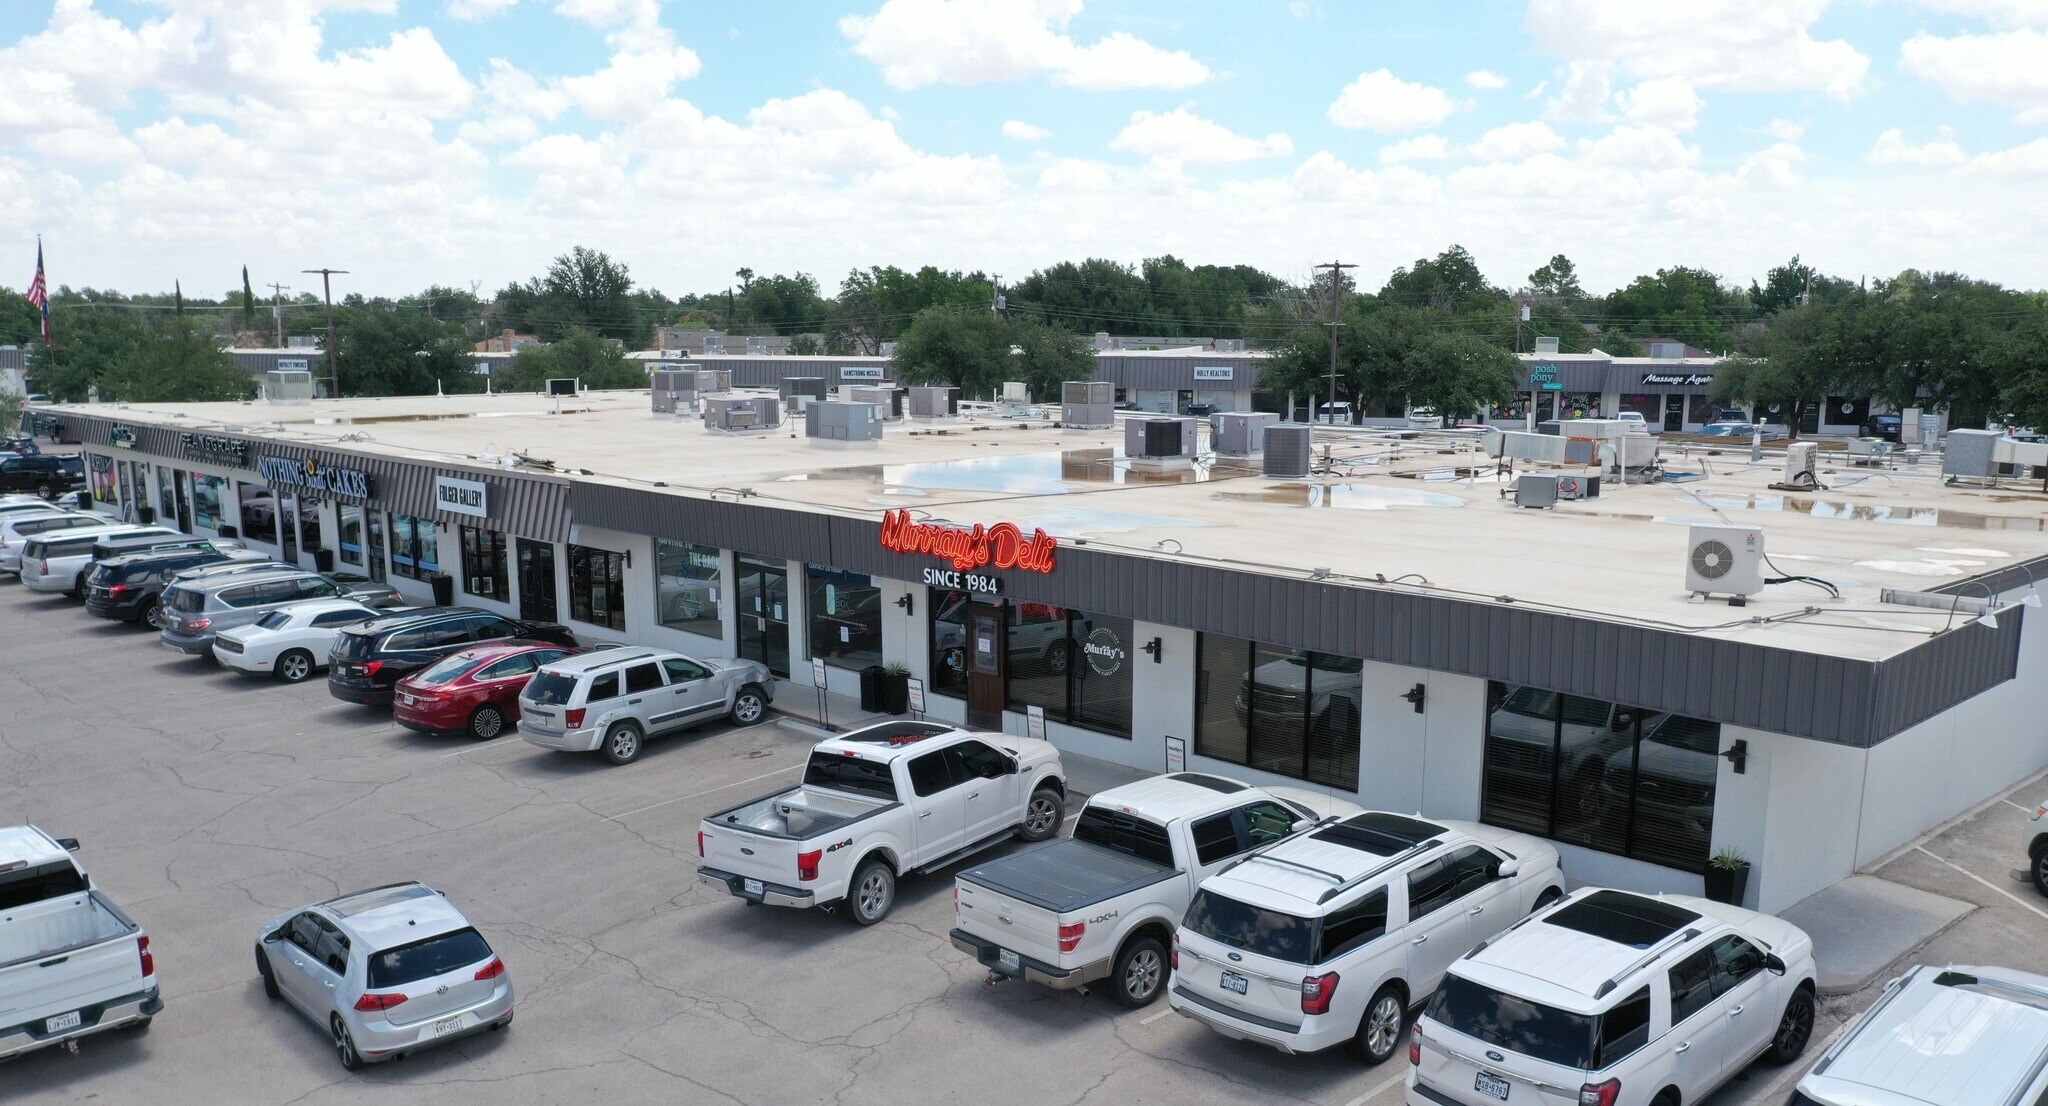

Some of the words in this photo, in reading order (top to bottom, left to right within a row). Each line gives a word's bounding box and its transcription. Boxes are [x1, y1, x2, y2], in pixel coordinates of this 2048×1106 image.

[1530, 373, 1553, 383] pony
[1535, 364, 1557, 373] posh
[1642, 373, 1684, 385] Massage
[257, 455, 304, 486] NOTHING
[326, 467, 368, 498] CAKES
[440, 484, 458, 504] FOLGER
[459, 487, 482, 508] GALLERY
[880, 508, 992, 572] Murray's
[988, 521, 1057, 574] Deli
[689, 551, 701, 567] THE
[923, 567, 961, 588] SINCE
[965, 574, 998, 594] 1984
